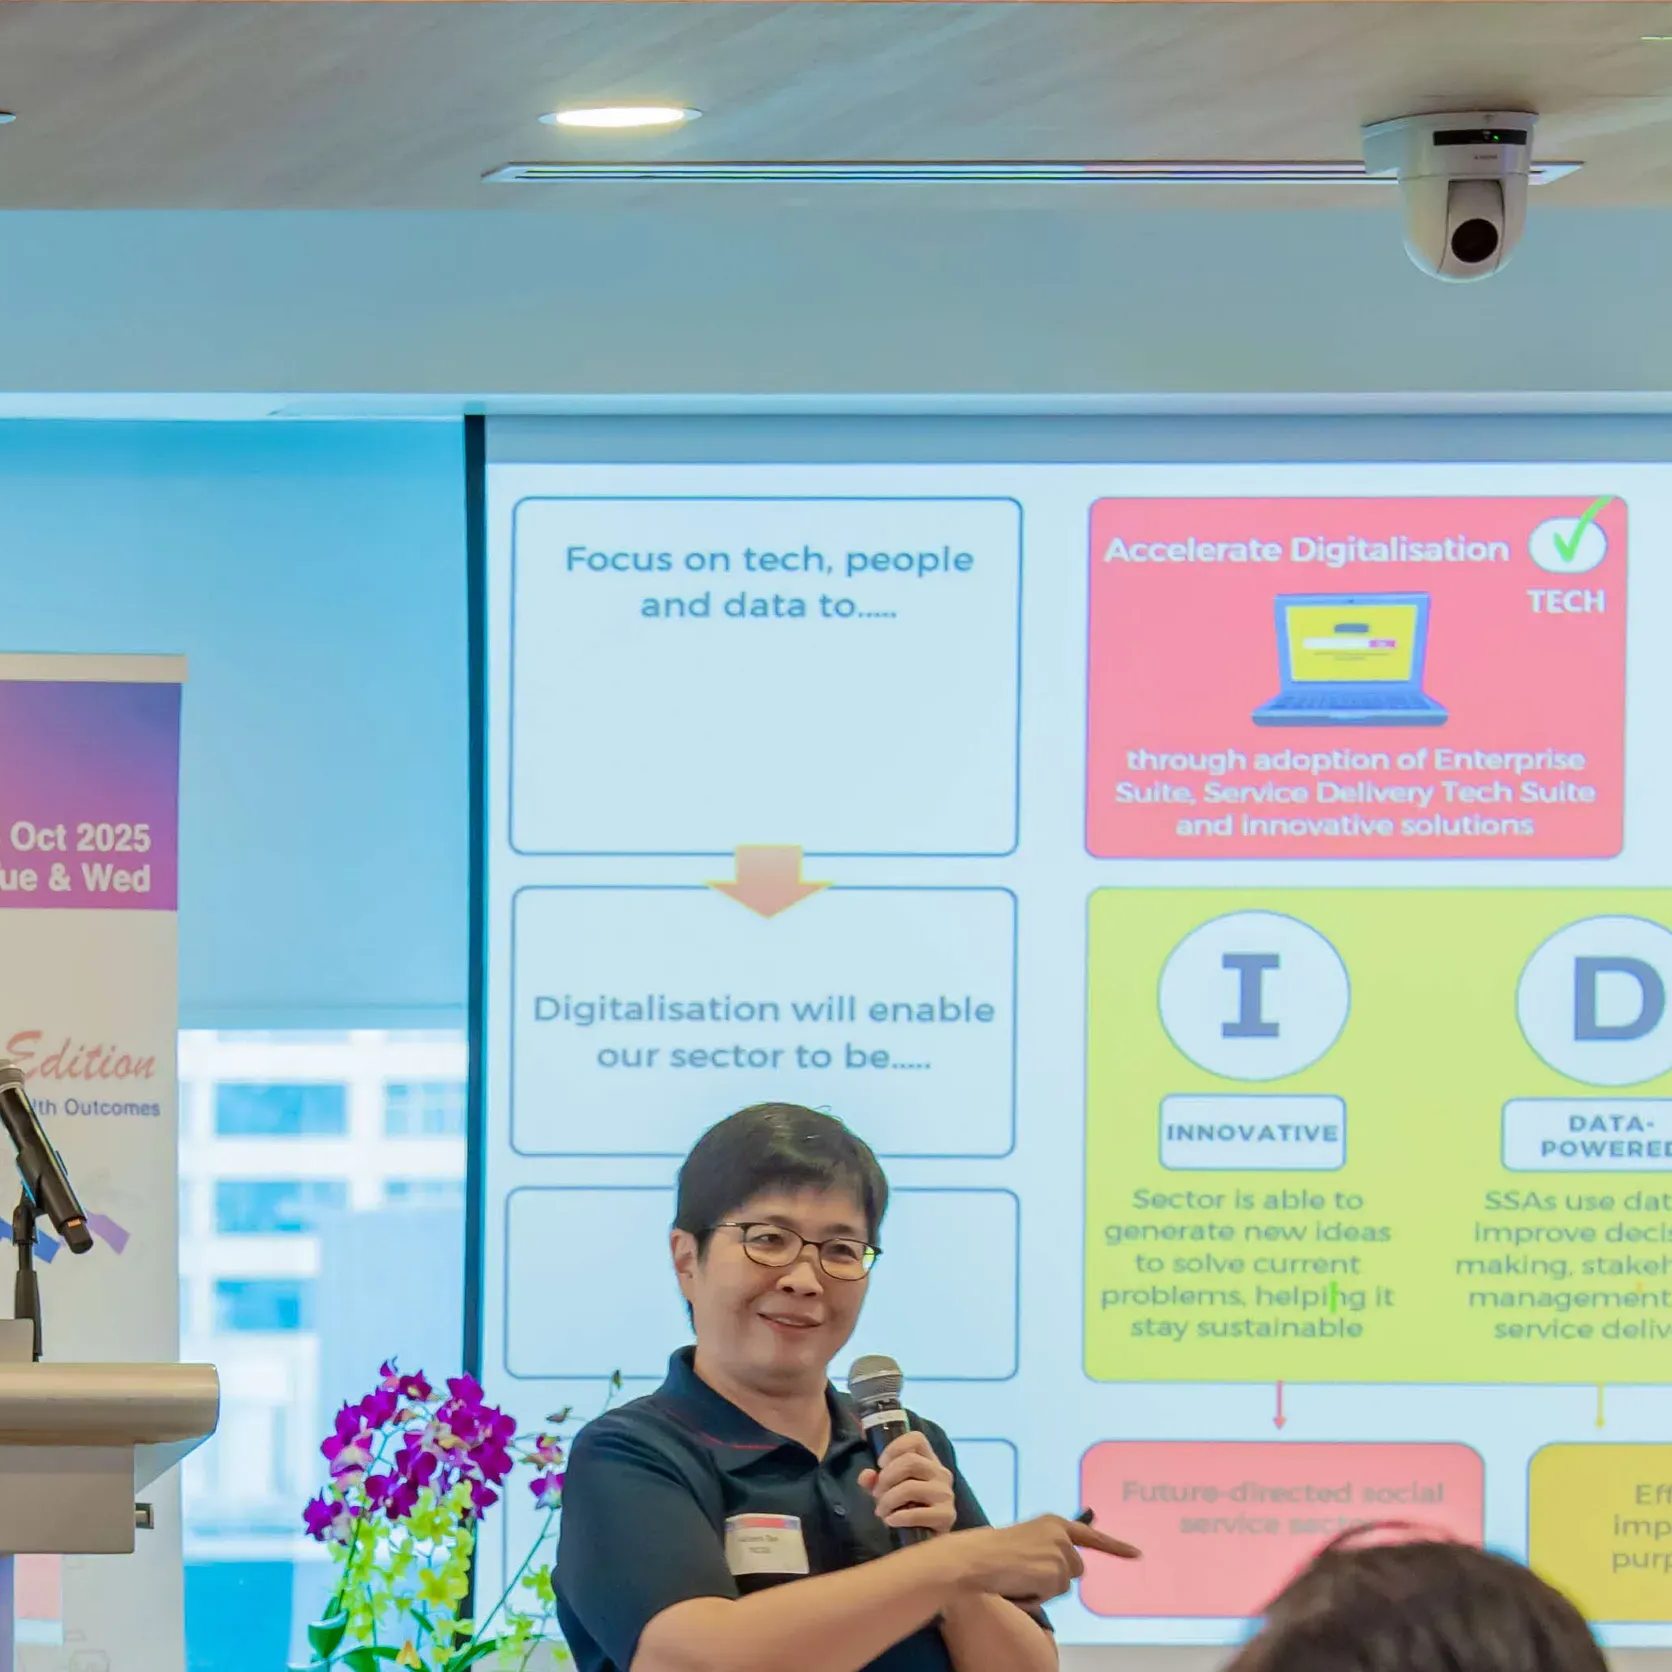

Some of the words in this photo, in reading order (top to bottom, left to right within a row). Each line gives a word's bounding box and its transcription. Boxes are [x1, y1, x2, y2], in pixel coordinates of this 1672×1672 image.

[566, 546, 673, 574] Focus
[683, 552, 731, 574] on
[743, 545, 833, 576] tech,
[845, 546, 975, 580] people
[1103, 536, 1284, 564] Accelerate
[1290, 534, 1512, 570] Digitalisation
[640, 591, 711, 620] and
[723, 591, 807, 620] data
[1526, 589, 1607, 615] TECH
[1126, 748, 1249, 778] through
[1253, 748, 1392, 777] adoption
[1395, 747, 1430, 772] of
[1434, 748, 1587, 777] Enterprise
[1114, 781, 1198, 807] Suite,
[1203, 780, 1311, 805] Service
[1316, 780, 1437, 810] Delivery
[1441, 780, 1515, 805] Tech
[1519, 780, 1598, 805] Suite
[10, 821, 67, 853] Oct
[76, 823, 152, 854] 2025
[1175, 813, 1235, 838] and
[1240, 813, 1396, 838] innovative
[1400, 813, 1536, 838] solutions
[48, 863, 72, 893] &
[81, 863, 151, 894] Wed
[1221, 953, 1281, 1040] I
[1573, 956, 1667, 1043] D
[533, 994, 781, 1029] Digitalisation
[790, 995, 857, 1024] will
[867, 996, 996, 1025] enable
[5, 1029, 157, 1081] Edition
[596, 1048, 661, 1070] our
[669, 1045, 785, 1071] sector
[794, 1045, 833, 1071] to
[63, 1098, 161, 1119] Outcomes
[1166, 1124, 1338, 1144] INNOVATIVE
[1568, 1114, 1655, 1134] DATA-
[1132, 1188, 1227, 1212] Sector
[1234, 1189, 1256, 1212] is
[1262, 1189, 1326, 1212] able
[1333, 1192, 1365, 1212] to
[1484, 1190, 1558, 1213] SSAs
[1564, 1195, 1616, 1214] use
[1103, 1222, 1237, 1248] generate
[1243, 1225, 1308, 1243] new
[1315, 1221, 1392, 1244] ideas
[1473, 1221, 1598, 1249] improve
[1134, 1254, 1166, 1275] to
[1171, 1253, 1246, 1276] solve
[1251, 1256, 1362, 1277] current
[1455, 1254, 1574, 1283] making,
[1130, 1318, 1190, 1344] stay
[1196, 1317, 1364, 1340] sustainable
[1493, 1318, 1595, 1341] service
